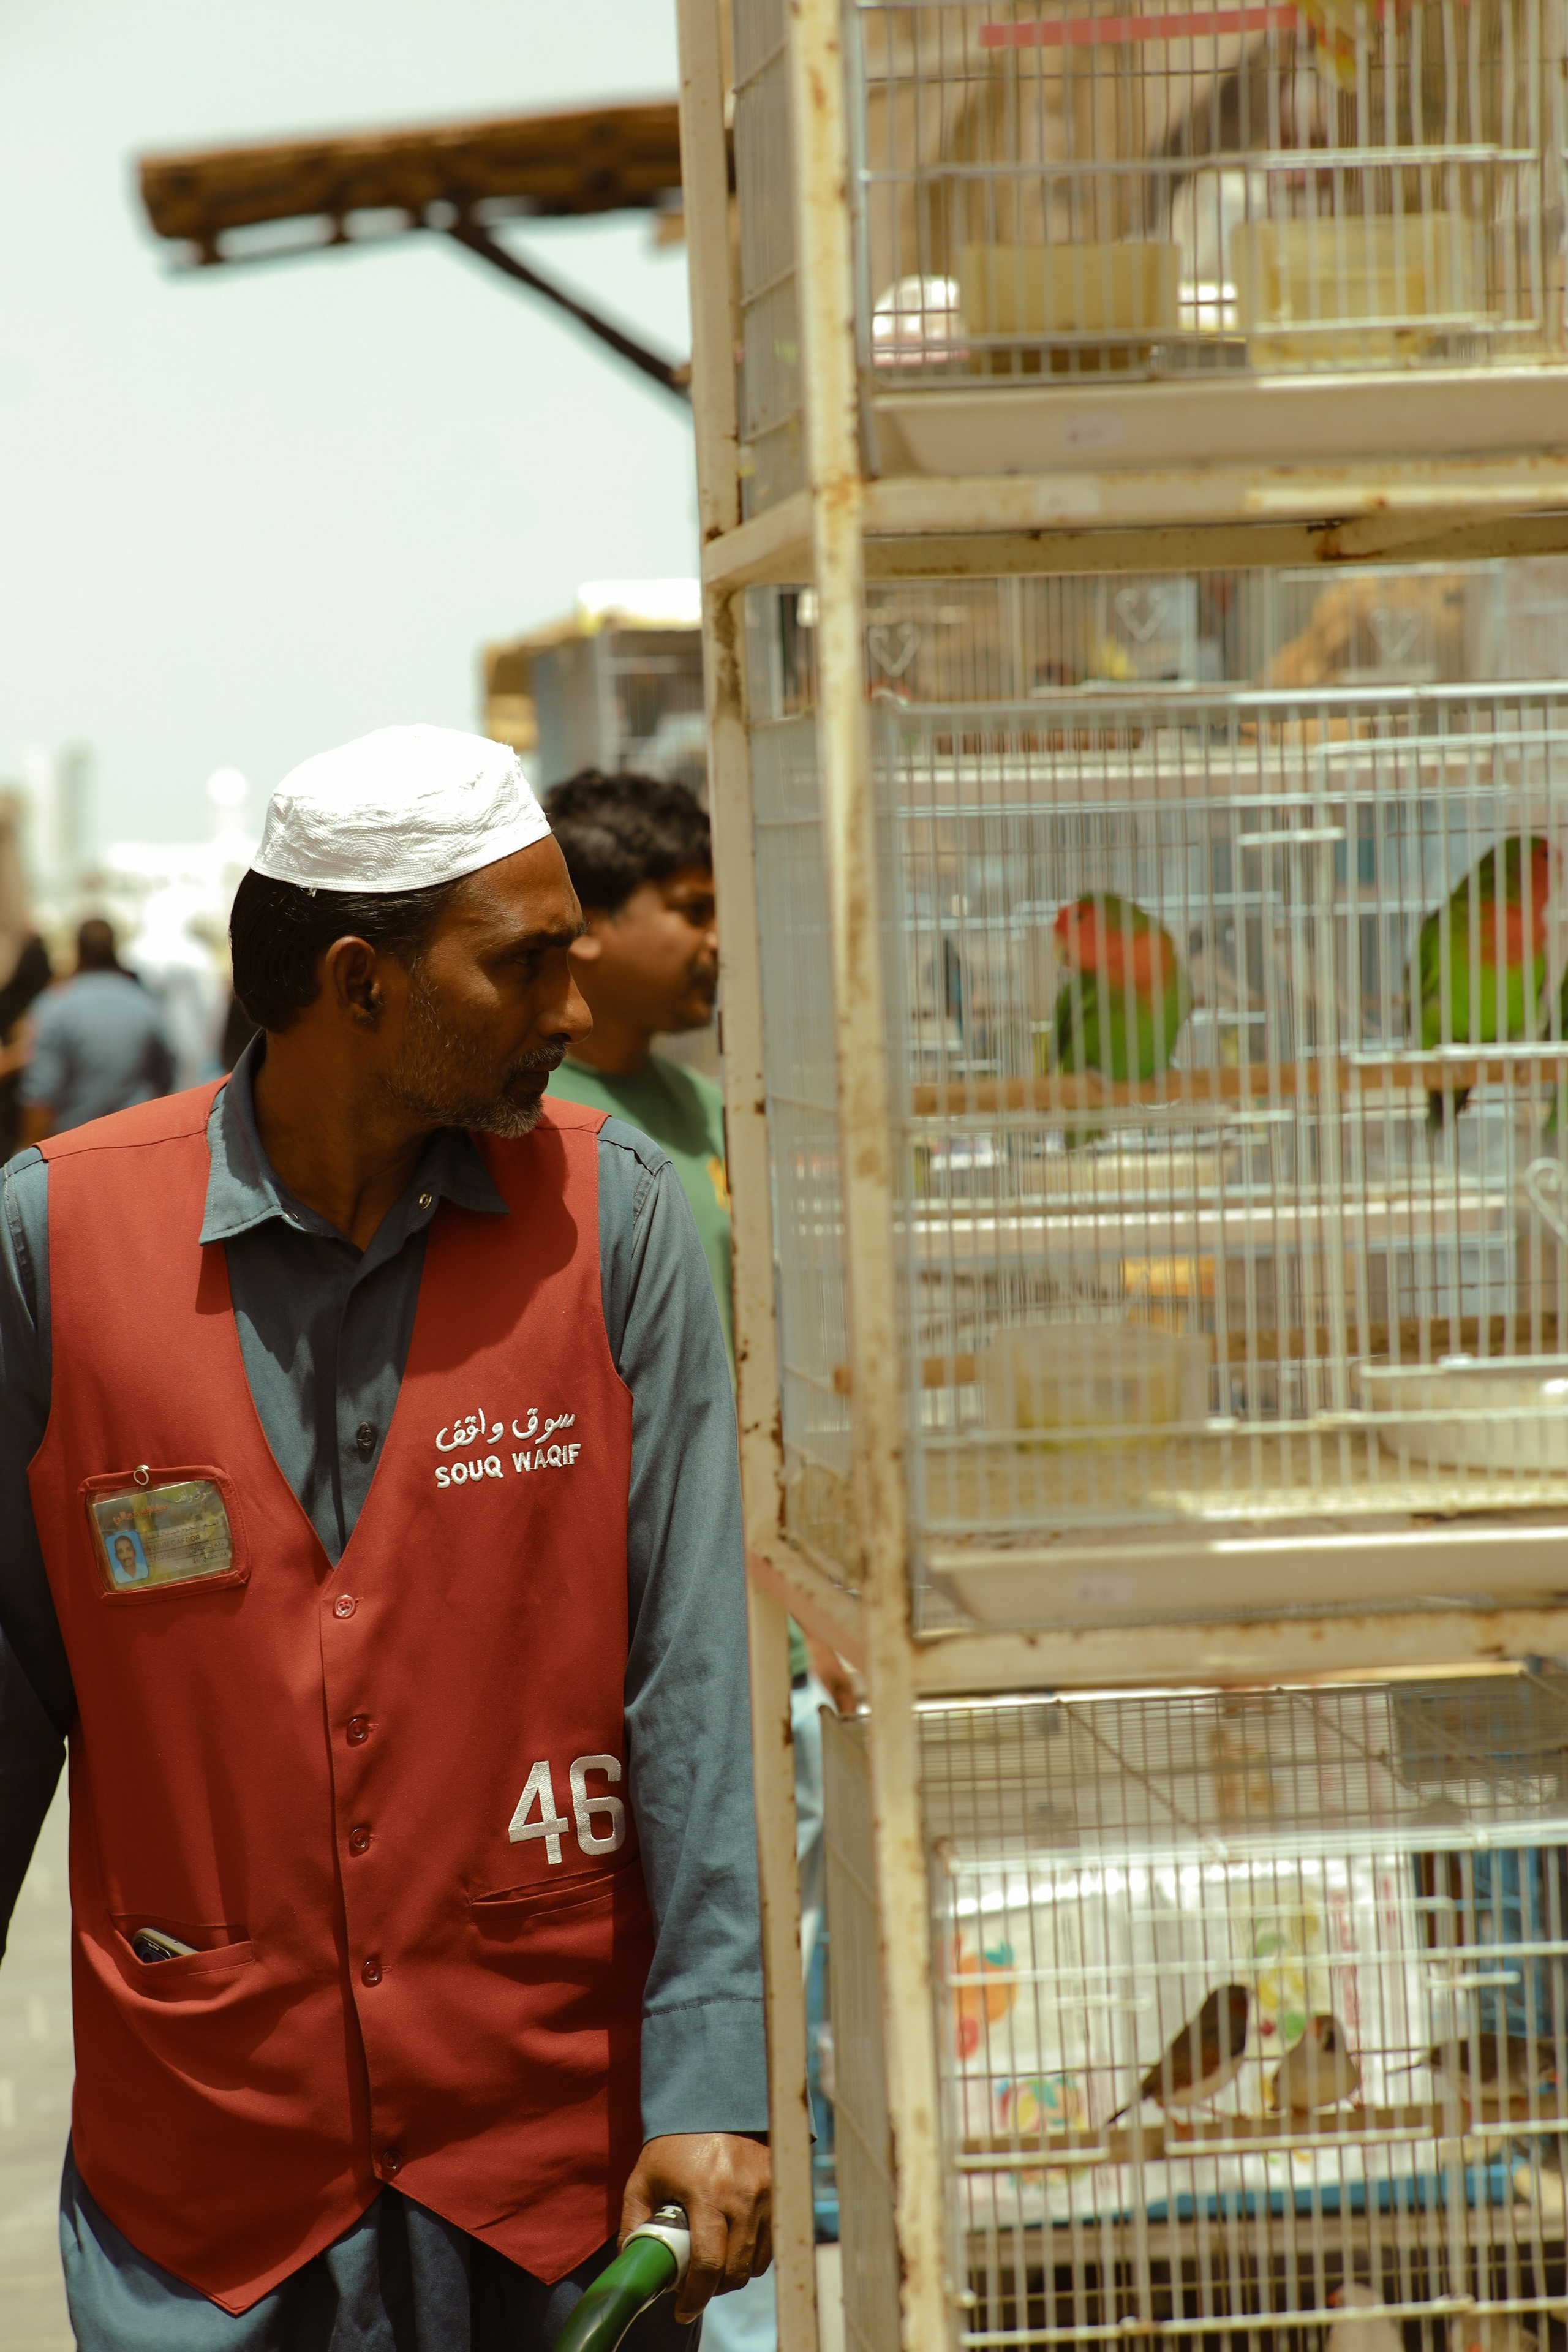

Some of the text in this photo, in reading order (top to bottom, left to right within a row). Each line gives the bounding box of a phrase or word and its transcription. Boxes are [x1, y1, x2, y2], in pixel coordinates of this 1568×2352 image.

[435, 1408, 576, 1452] سوق واقف
[435, 1444, 581, 1488] SOUQ WAQIF
[508, 1754, 626, 1865] 46
